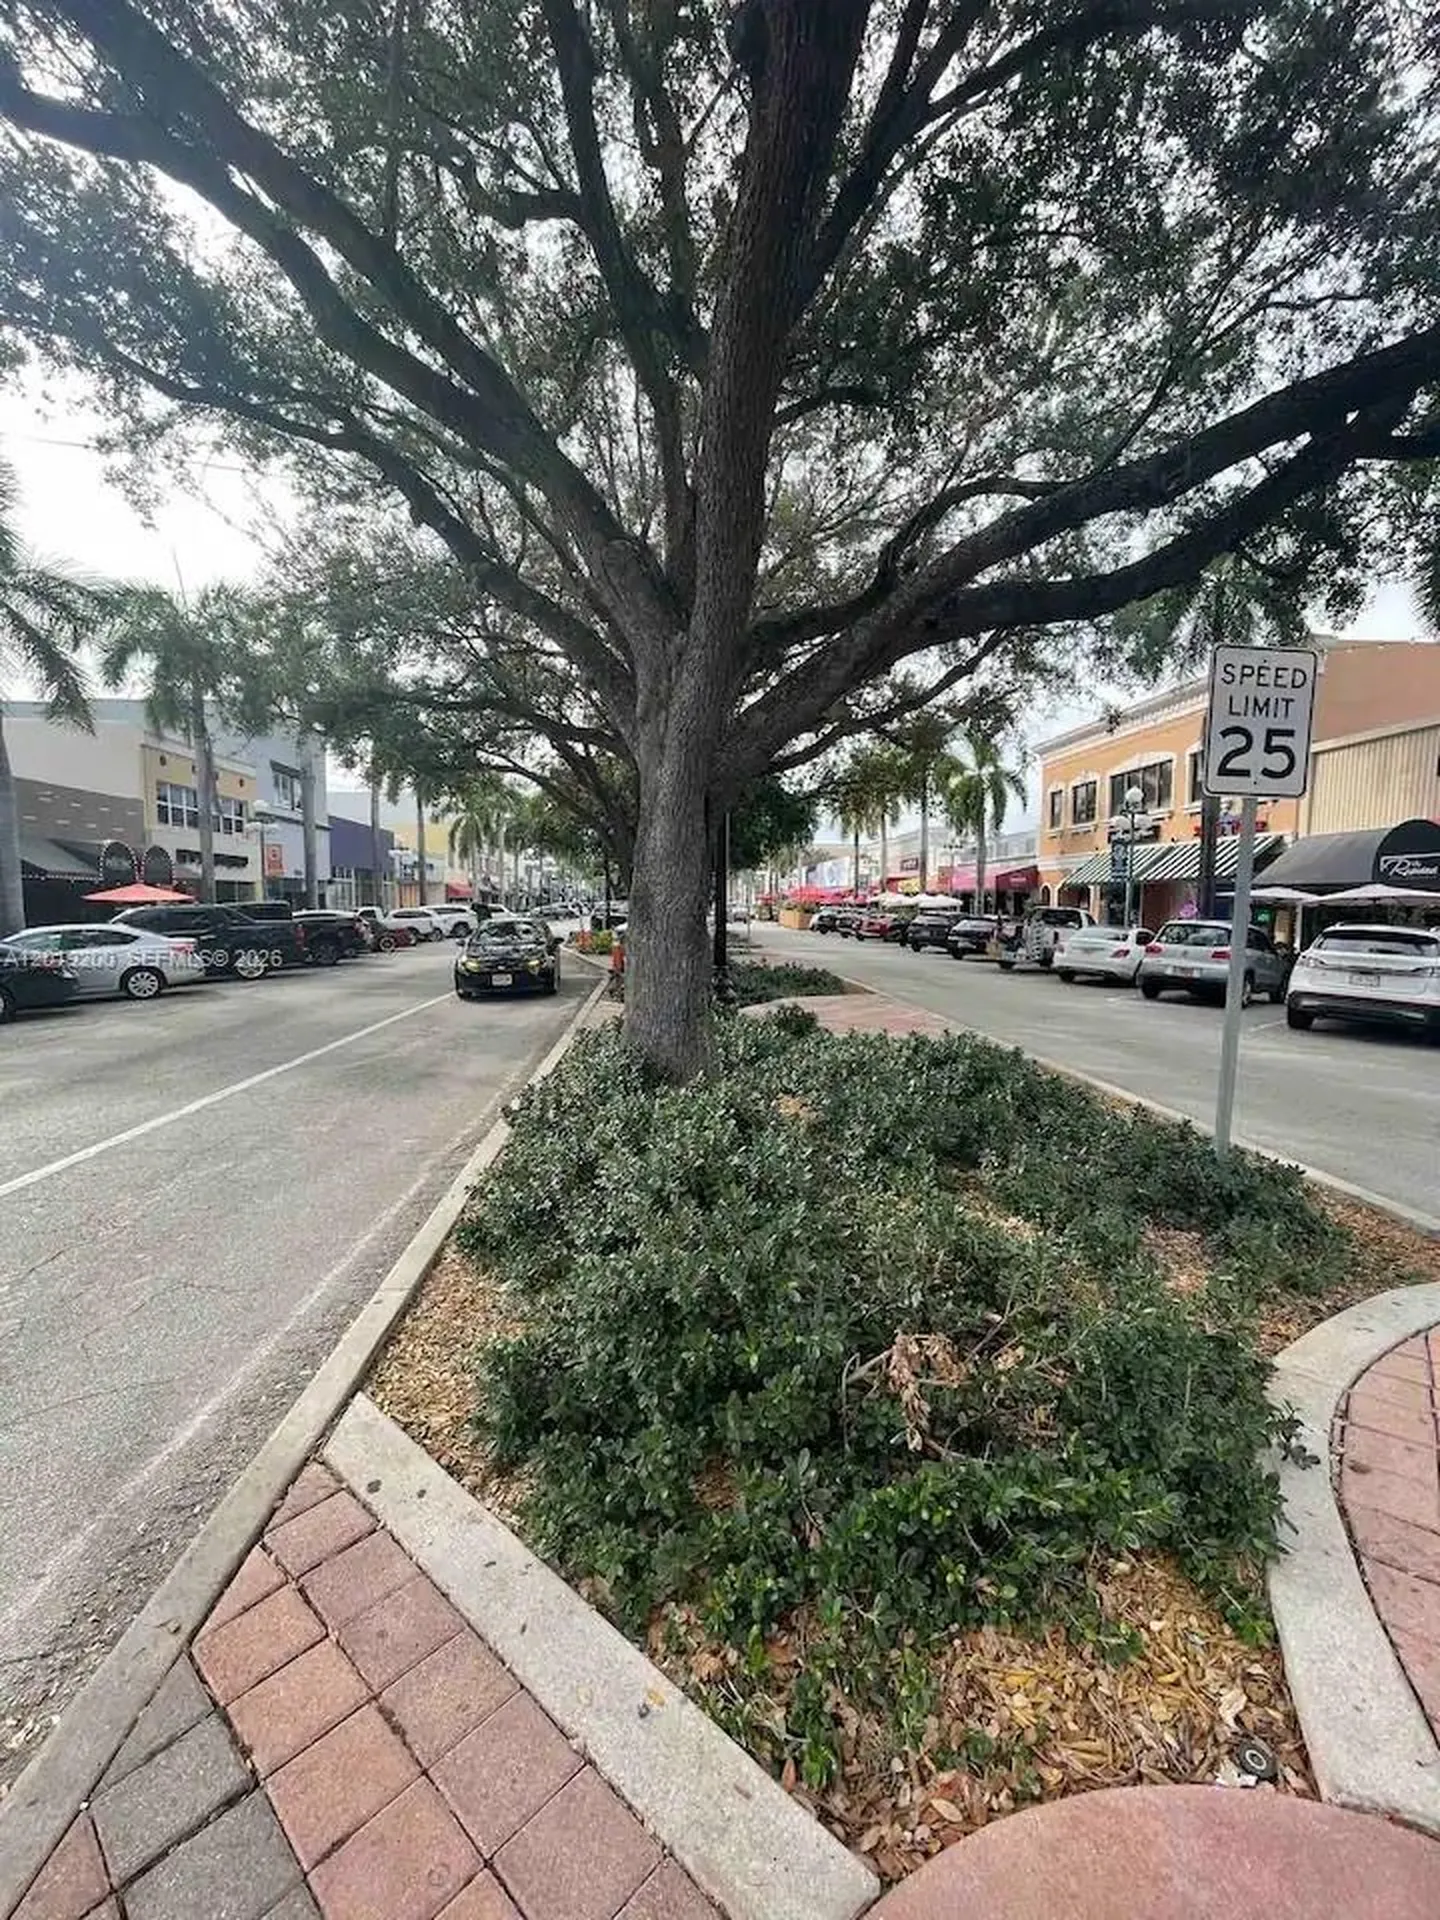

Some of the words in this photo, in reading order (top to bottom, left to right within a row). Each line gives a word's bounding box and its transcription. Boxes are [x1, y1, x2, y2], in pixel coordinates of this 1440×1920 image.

[1221, 663, 1307, 689] SPEED
[1228, 695, 1295, 719] LIMIT
[1216, 725, 1296, 779] 25
